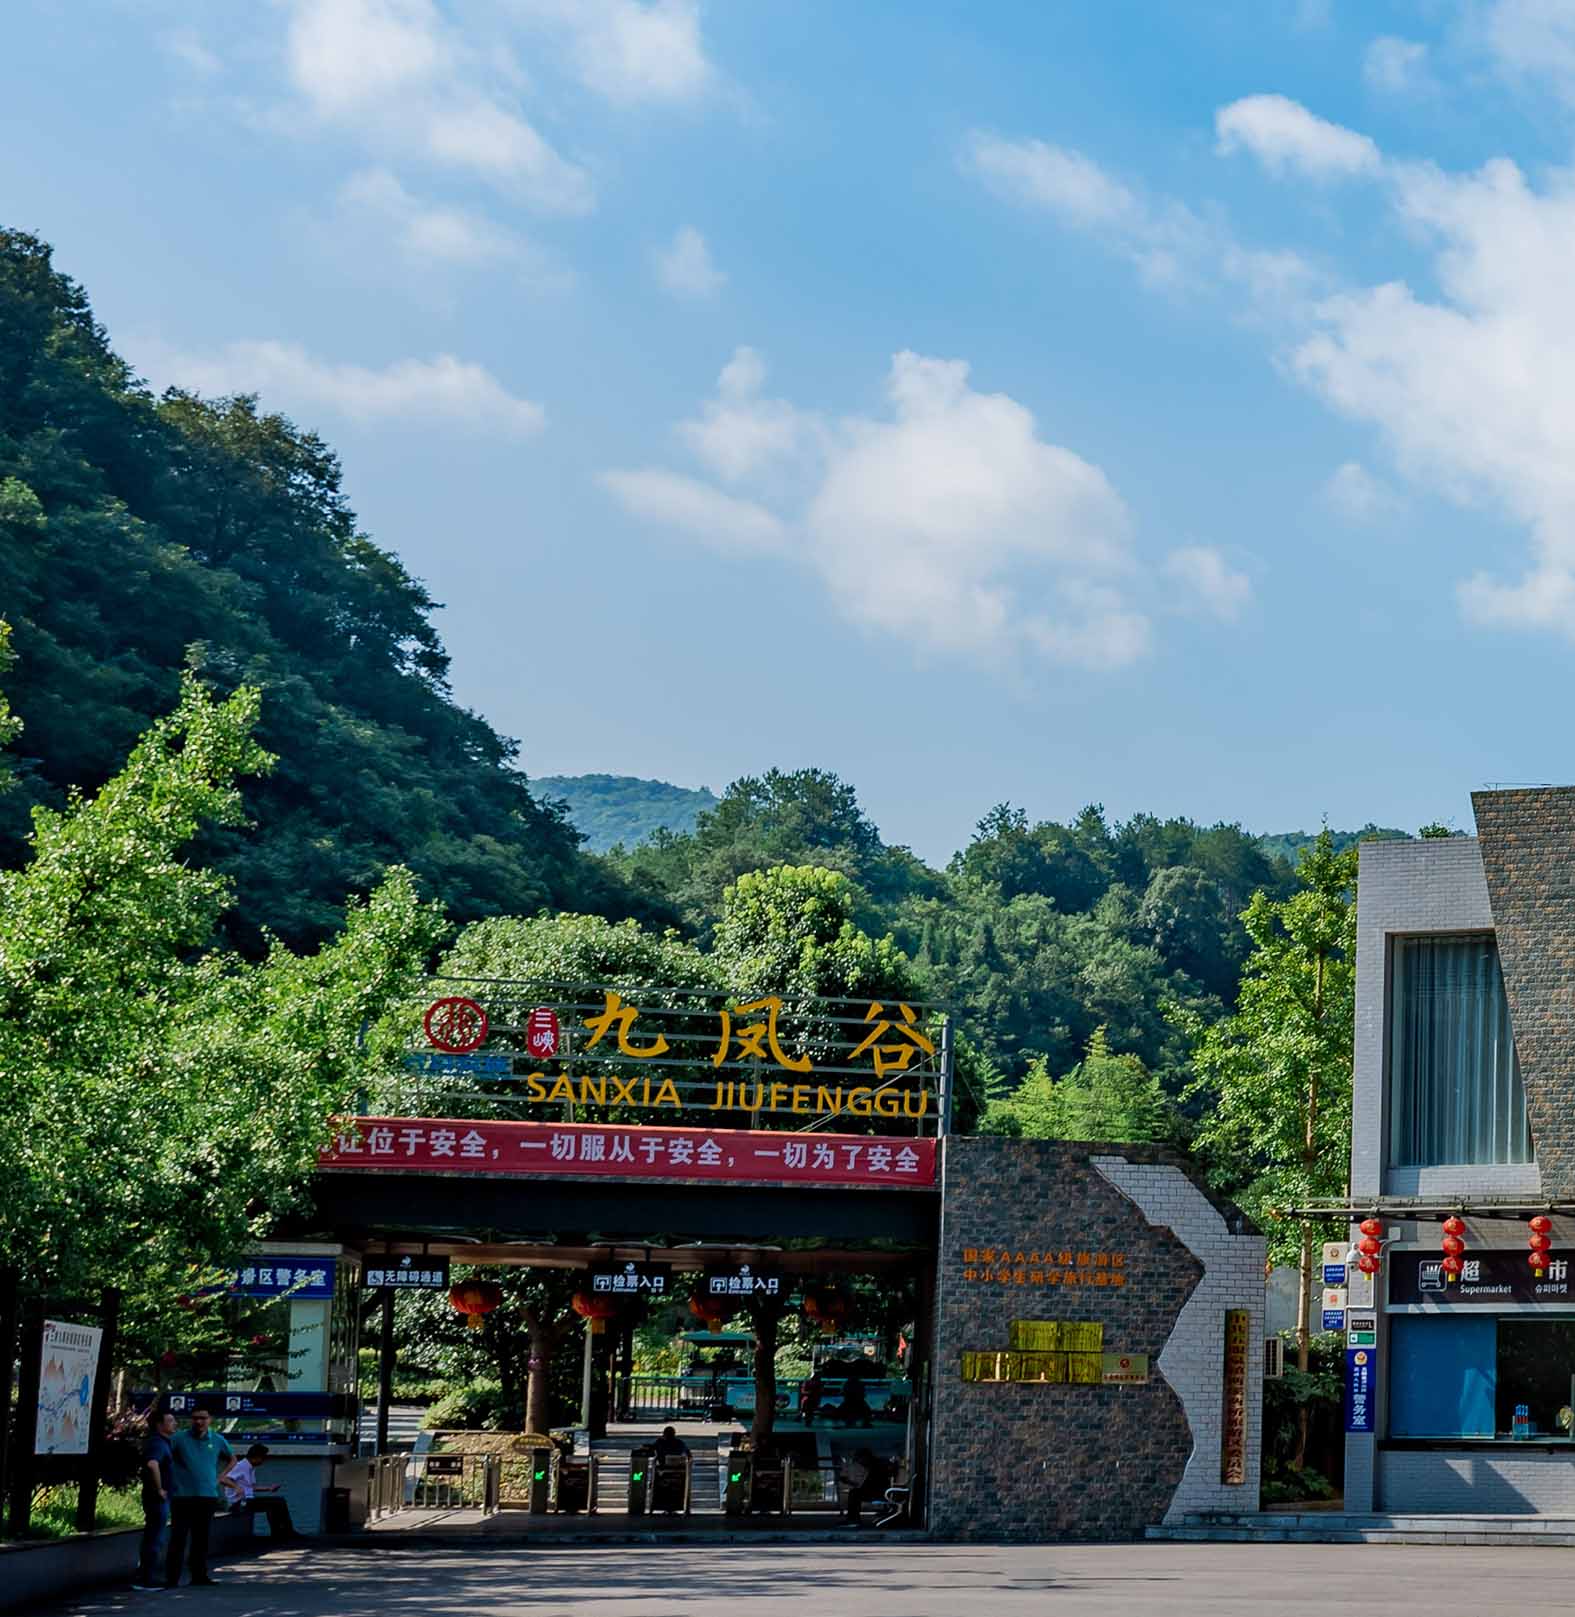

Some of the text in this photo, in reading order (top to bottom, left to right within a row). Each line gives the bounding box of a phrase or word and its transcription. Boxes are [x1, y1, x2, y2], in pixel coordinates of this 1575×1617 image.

[581, 992, 935, 1079] 九凤谷
[527, 1072, 928, 1118] SANXIA JIUFENGGU
[1460, 1284, 1512, 1295] Supermarket
